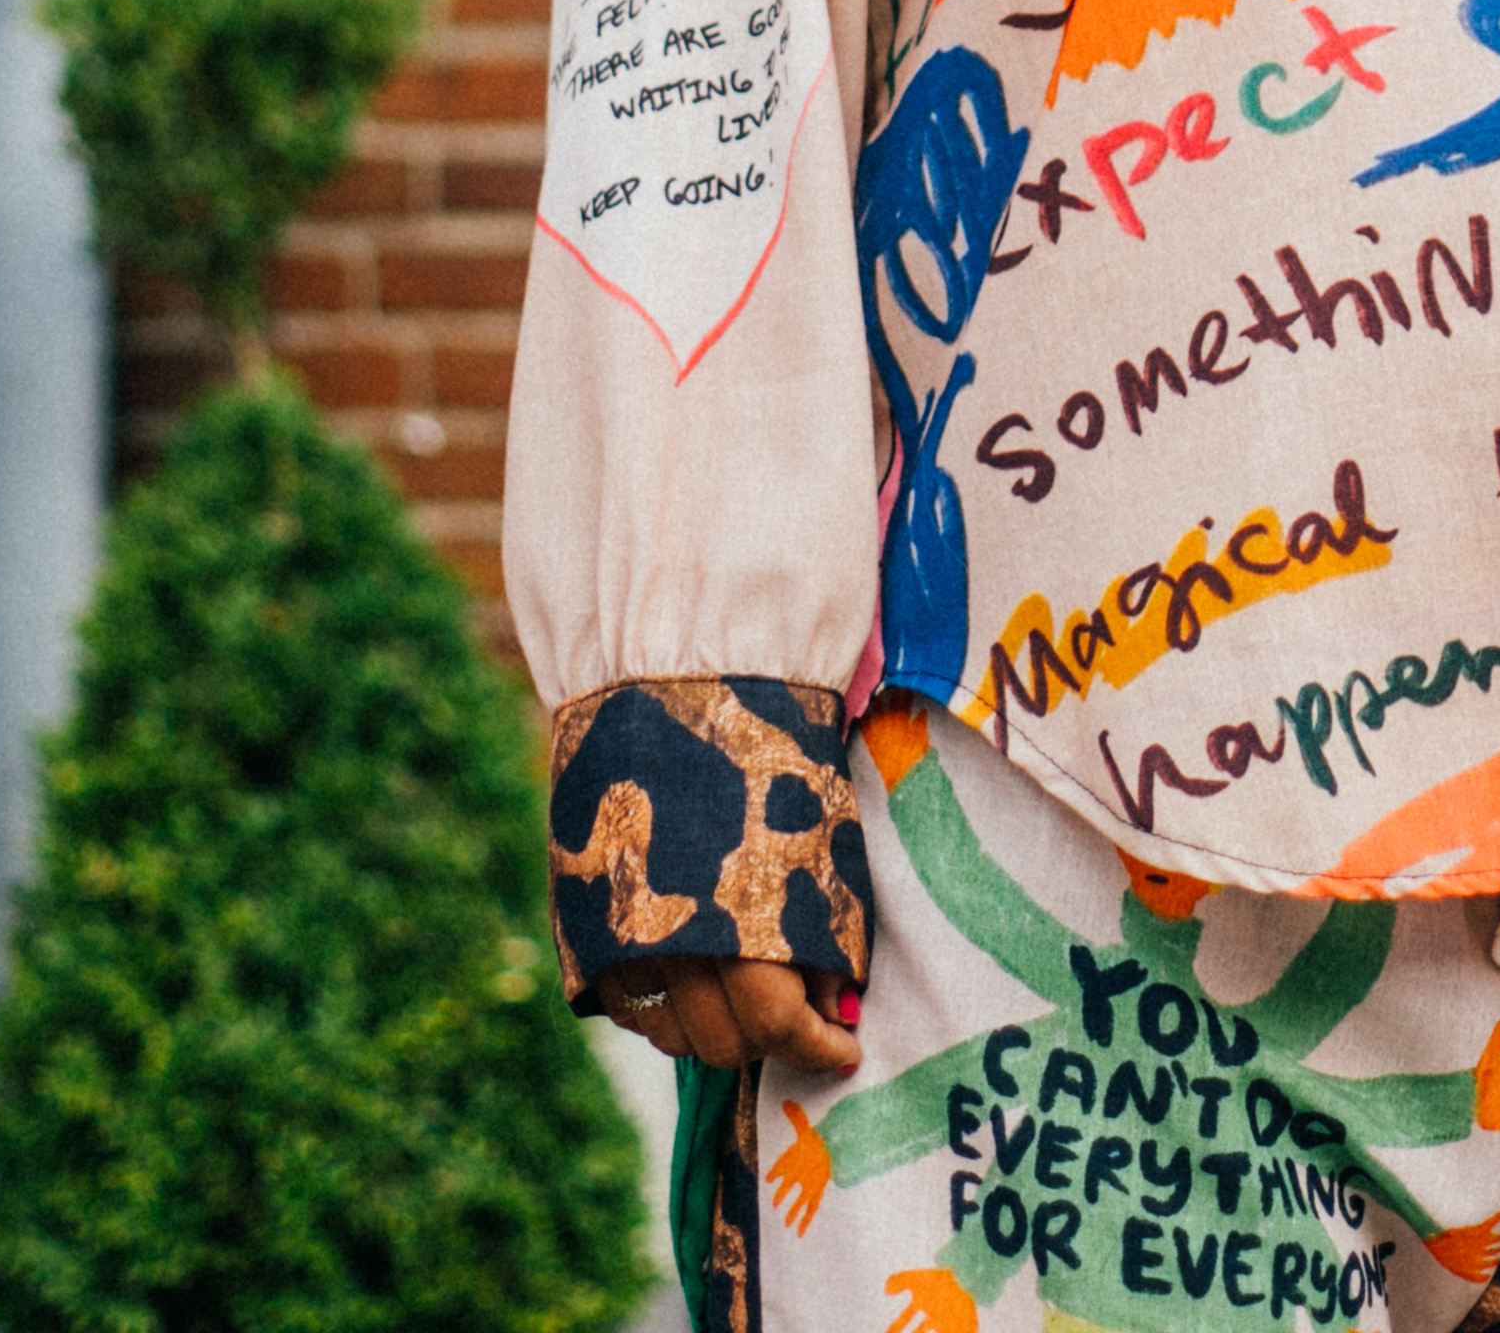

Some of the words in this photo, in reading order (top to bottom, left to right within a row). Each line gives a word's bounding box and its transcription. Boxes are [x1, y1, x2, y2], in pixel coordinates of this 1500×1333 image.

[564, 39, 645, 101] THERE
[663, 22, 727, 57] ARE
[609, 69, 754, 120] WAITING
[579, 176, 642, 228] KEEP
[663, 148, 775, 206] GOING!
[1068, 944, 1260, 1068] YOU
[1245, 1077, 1348, 1151] DO
[949, 1169, 1083, 1276] FOR
